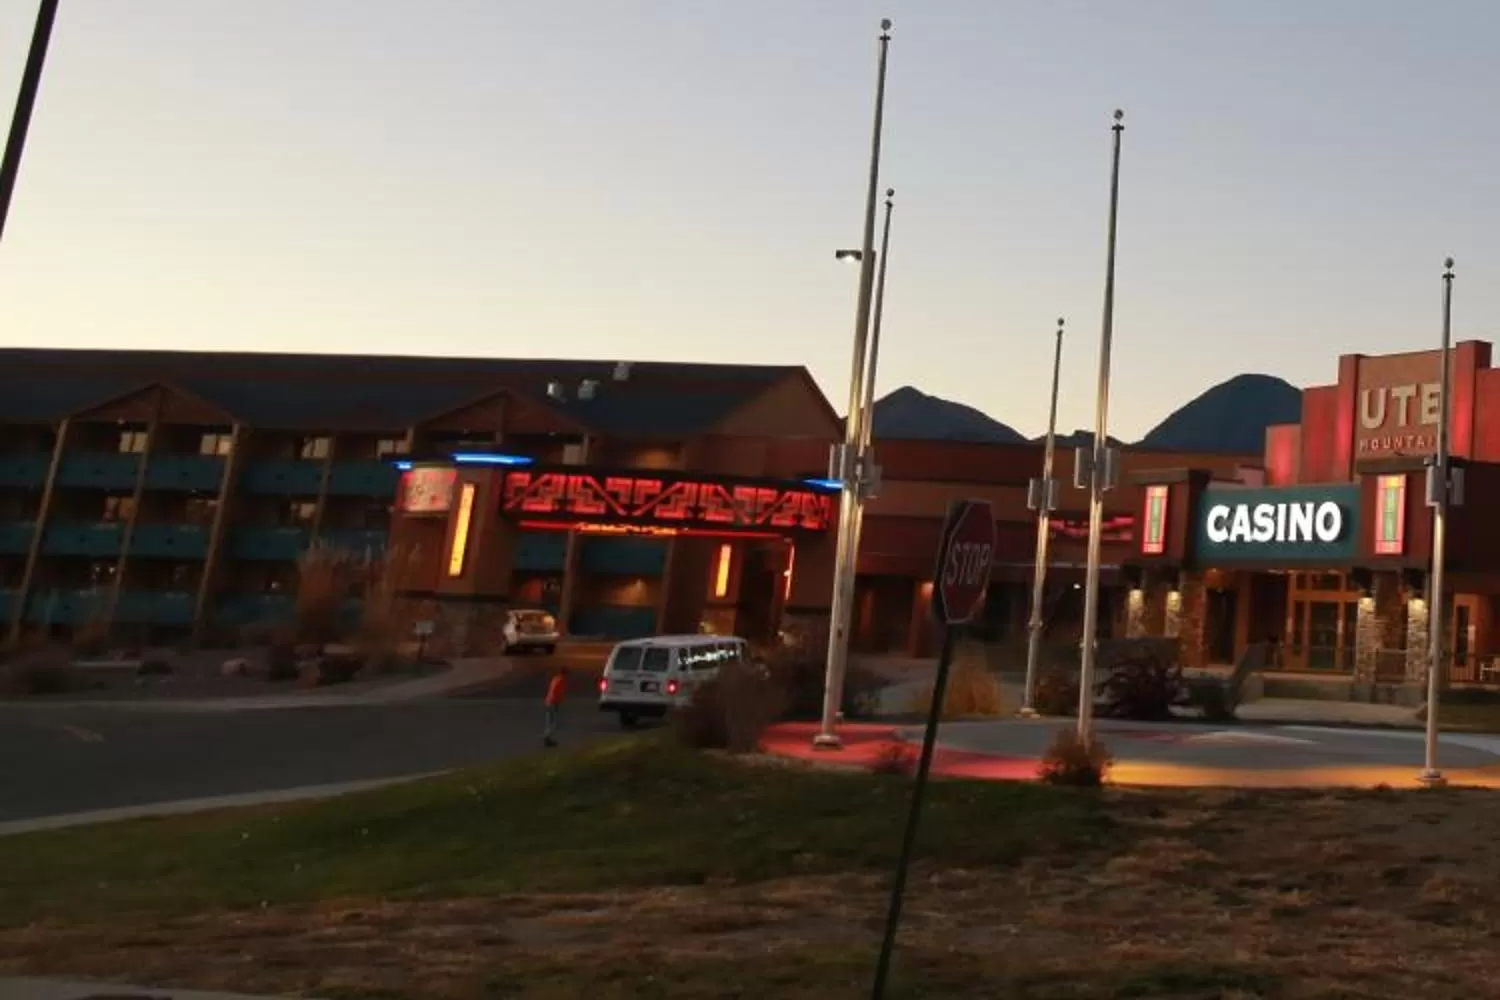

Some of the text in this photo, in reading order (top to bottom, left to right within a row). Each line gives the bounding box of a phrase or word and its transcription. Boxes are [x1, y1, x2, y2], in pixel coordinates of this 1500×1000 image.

[1361, 383, 1441, 429] UTE
[1360, 435, 1436, 450] MOUNTAI
[1206, 501, 1342, 543] CASINO
[947, 543, 991, 586] STOP
